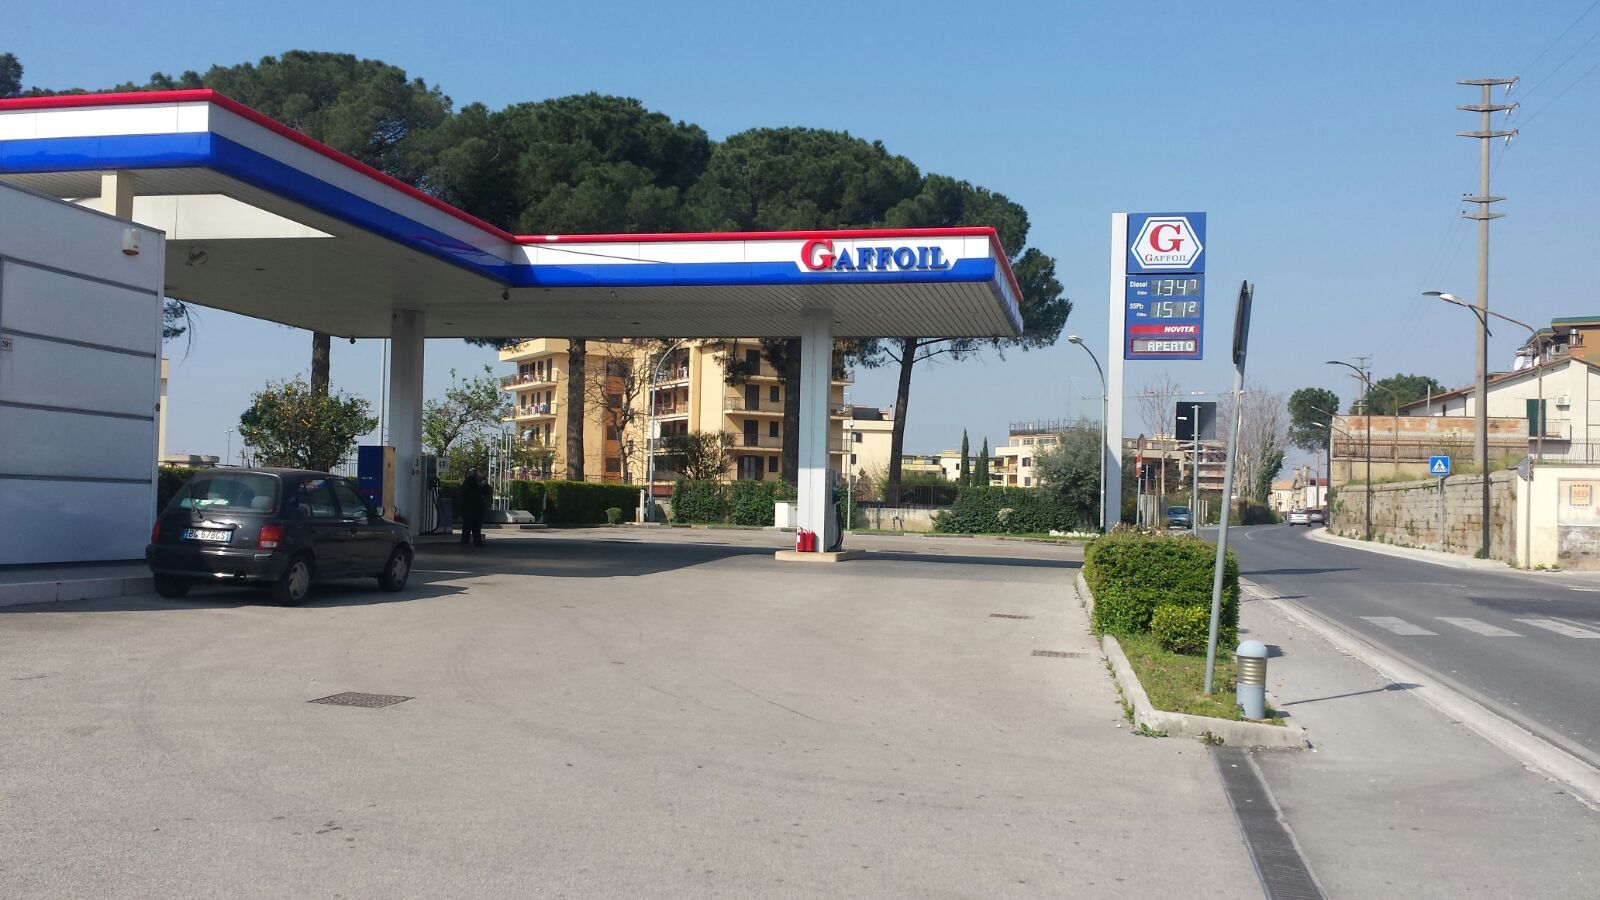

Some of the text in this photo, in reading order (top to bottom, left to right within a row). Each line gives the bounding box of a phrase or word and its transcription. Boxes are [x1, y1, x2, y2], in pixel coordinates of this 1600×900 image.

[1149, 223, 1185, 253] G
[801, 238, 949, 271] GAFFOIL
[1144, 253, 1189, 262] GAFFOIL
[1129, 280, 1148, 288] Diesel
[1147, 341, 1194, 352] APERTO
